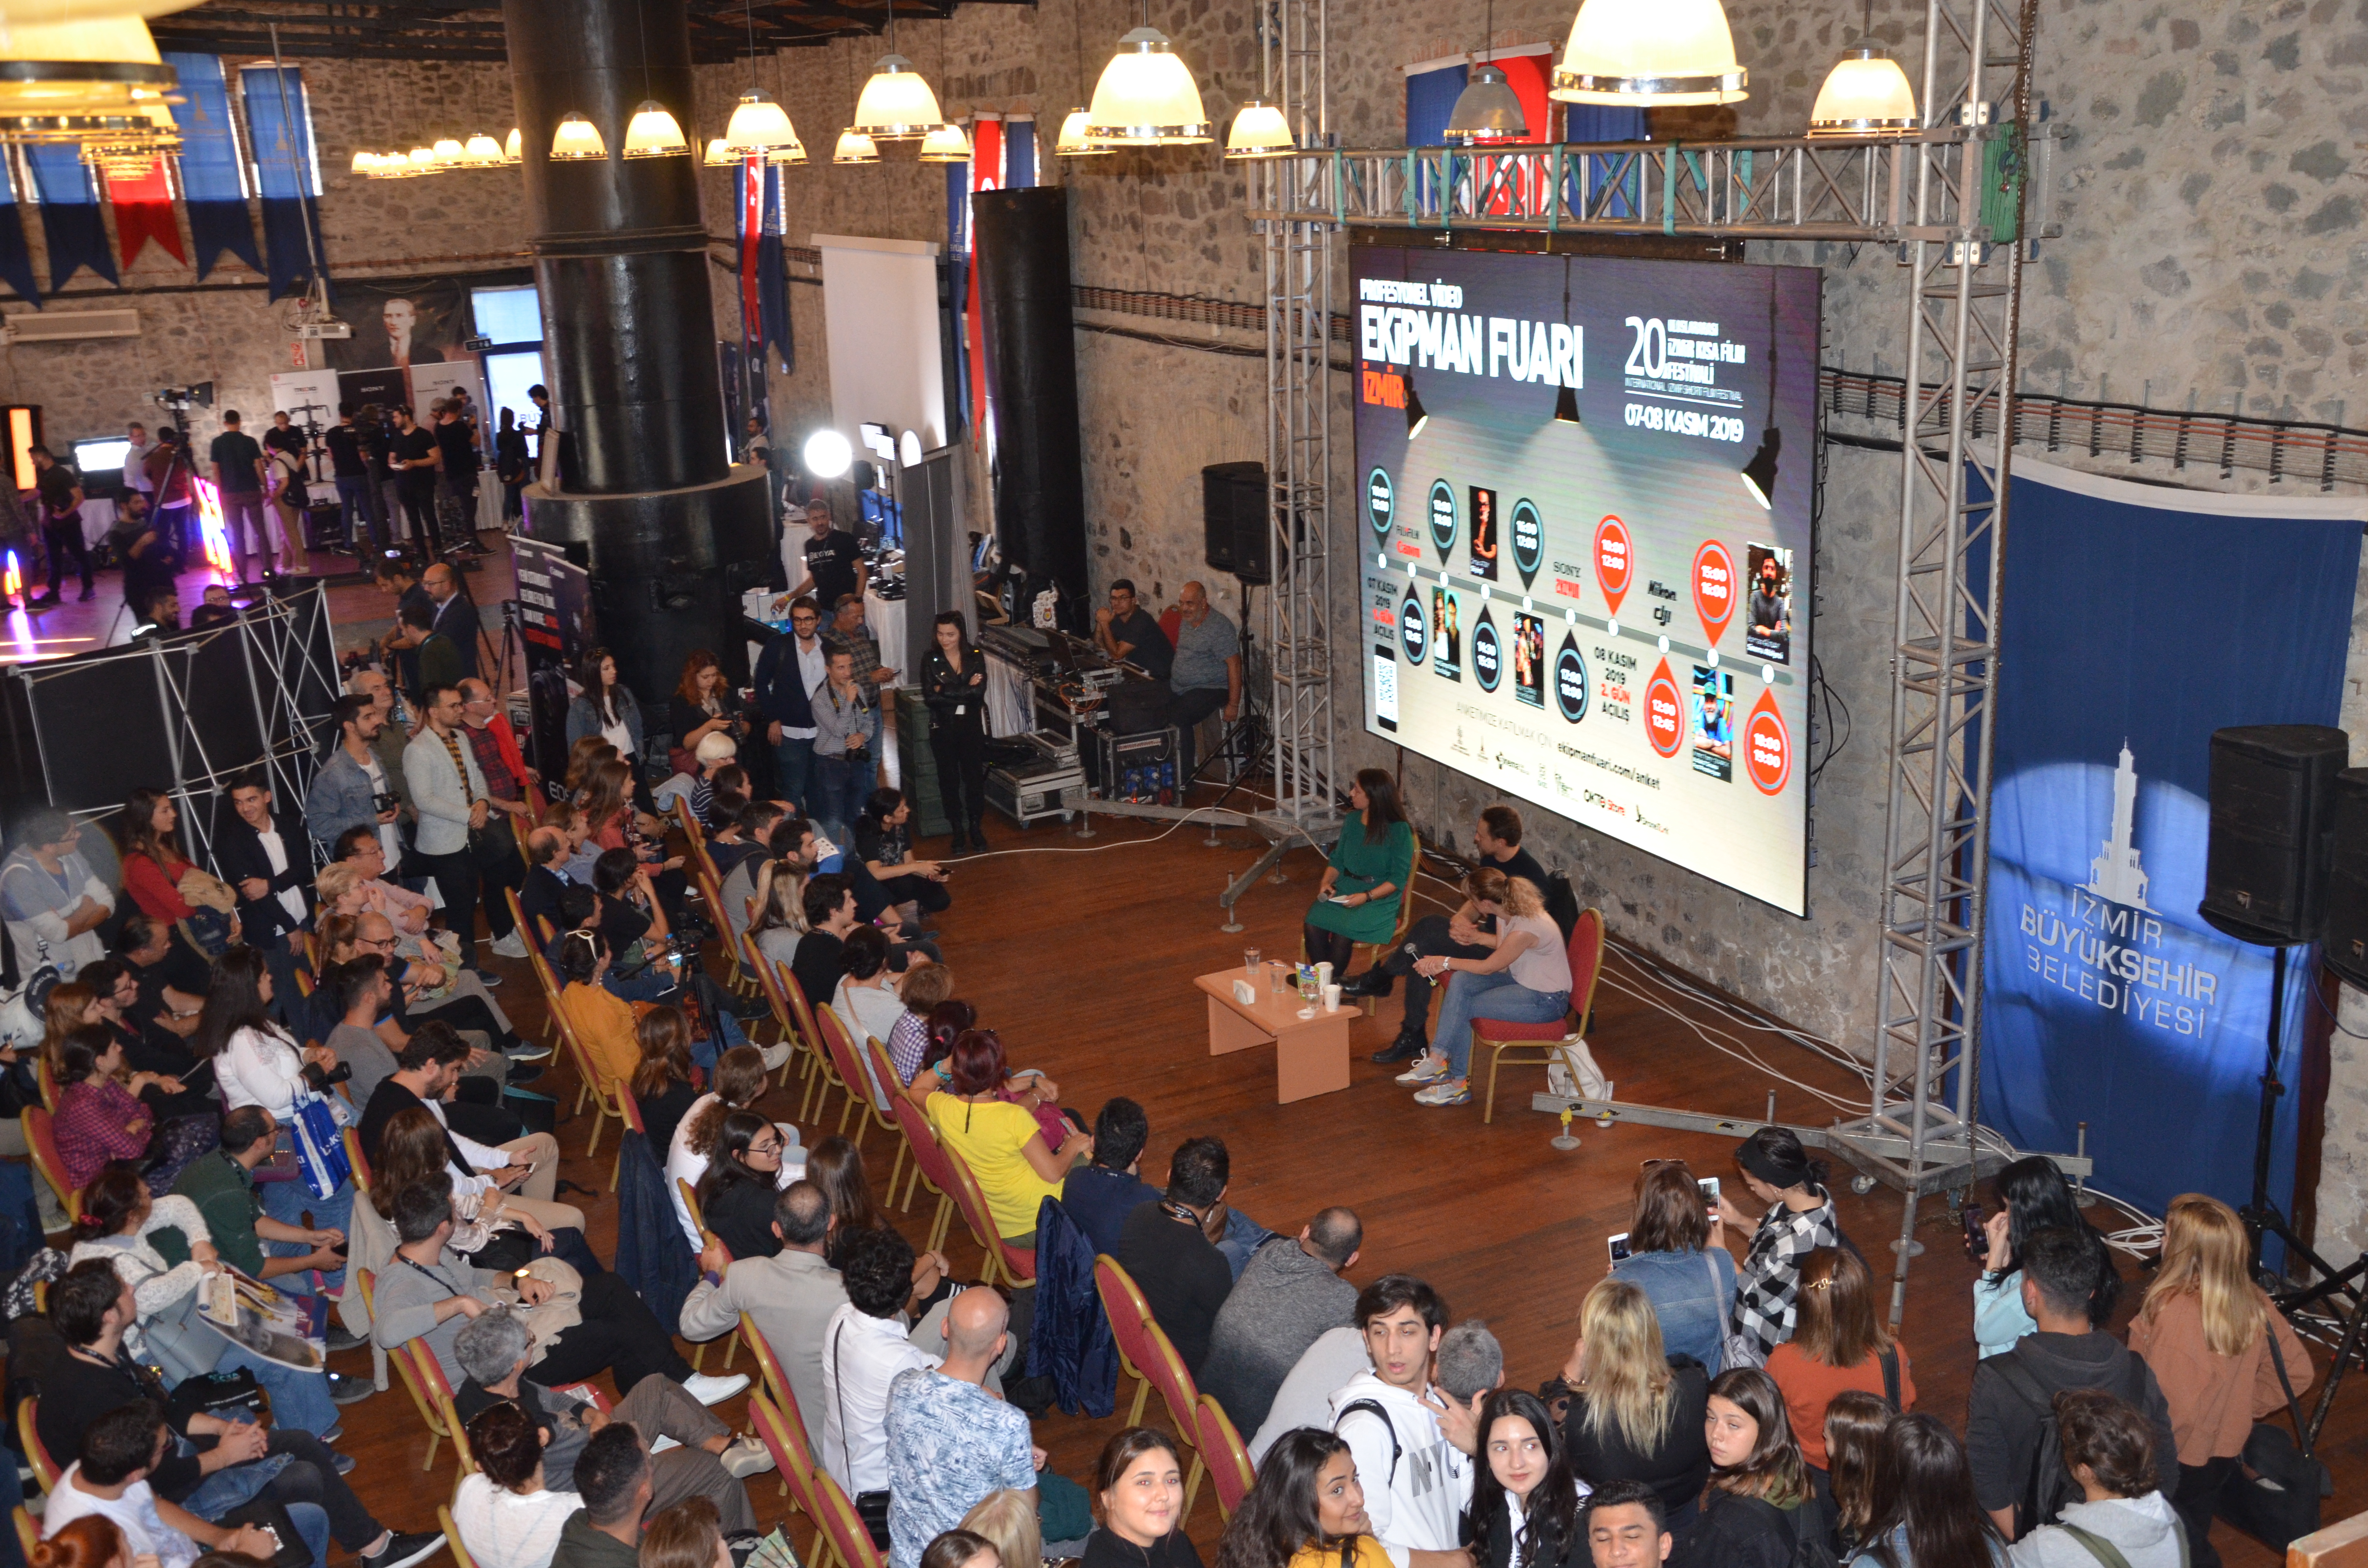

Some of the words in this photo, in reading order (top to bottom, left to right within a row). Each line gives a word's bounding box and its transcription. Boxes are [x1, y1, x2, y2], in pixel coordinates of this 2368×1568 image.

[1360, 278, 1431, 306] PROFESYONEL
[1430, 278, 1463, 309] VİDEO
[1489, 317, 1584, 389] FUARI
[1362, 361, 1405, 409] İZMİR
[1625, 403, 1664, 430] 07-08
[1664, 409, 1709, 437] KASIM
[1709, 415, 1744, 442] 2019
[1601, 539, 1625, 555] 10:00
[1553, 561, 1581, 578] SONY
[1601, 554, 1625, 570] 12:00
[1701, 565, 1727, 582] 15:00
[1652, 699, 1676, 716] 12:00
[1652, 714, 1675, 732] 12:45
[1753, 749, 1781, 768] 19:00
[2071, 888, 2162, 948] İZMİR
[2020, 903, 2217, 1005] BÜYÜKŞEHİR
[2028, 944, 2205, 1039] BELEDİYESİ
